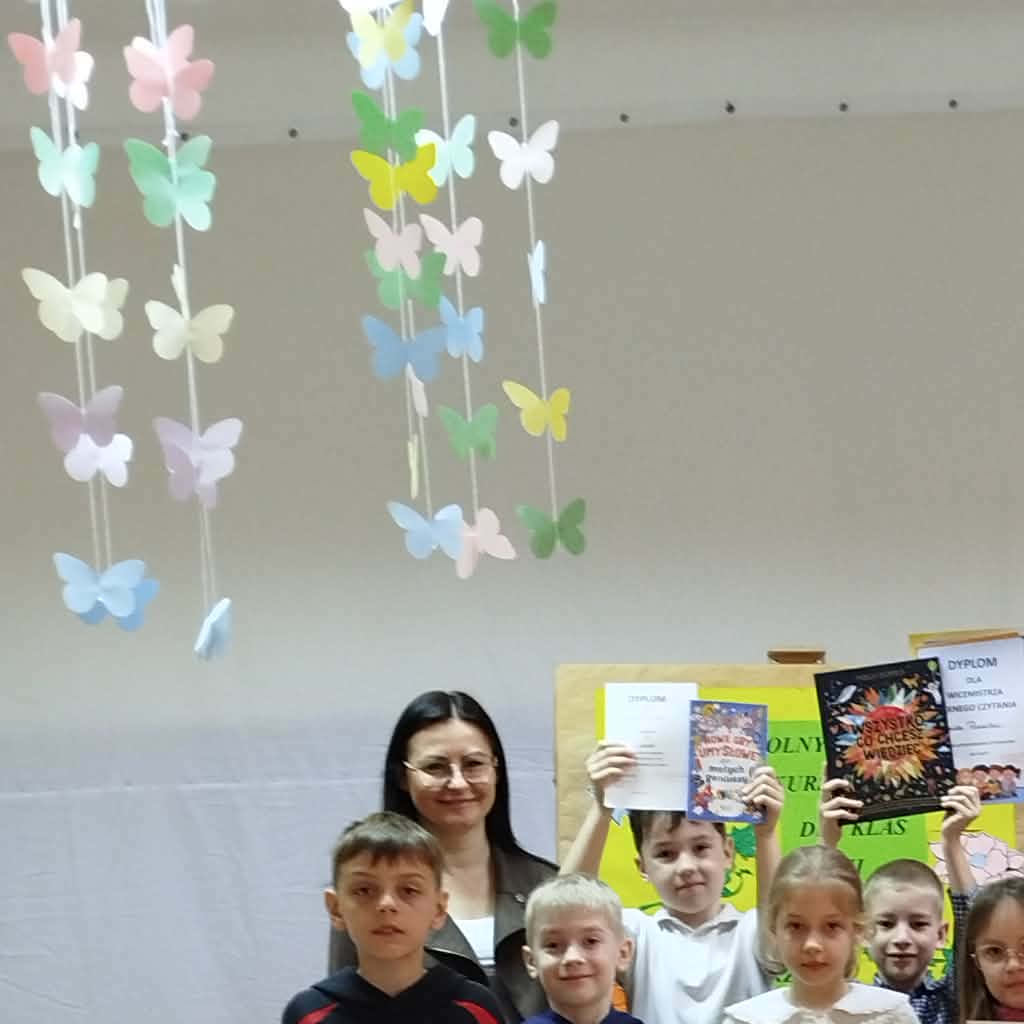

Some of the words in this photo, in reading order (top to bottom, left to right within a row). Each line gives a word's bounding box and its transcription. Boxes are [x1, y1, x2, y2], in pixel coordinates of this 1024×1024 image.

[947, 656, 998, 670] DYPLOM
[966, 676, 983, 684] DLA
[768, 736, 825, 754] OLNY
[851, 818, 908, 837] KLAS
